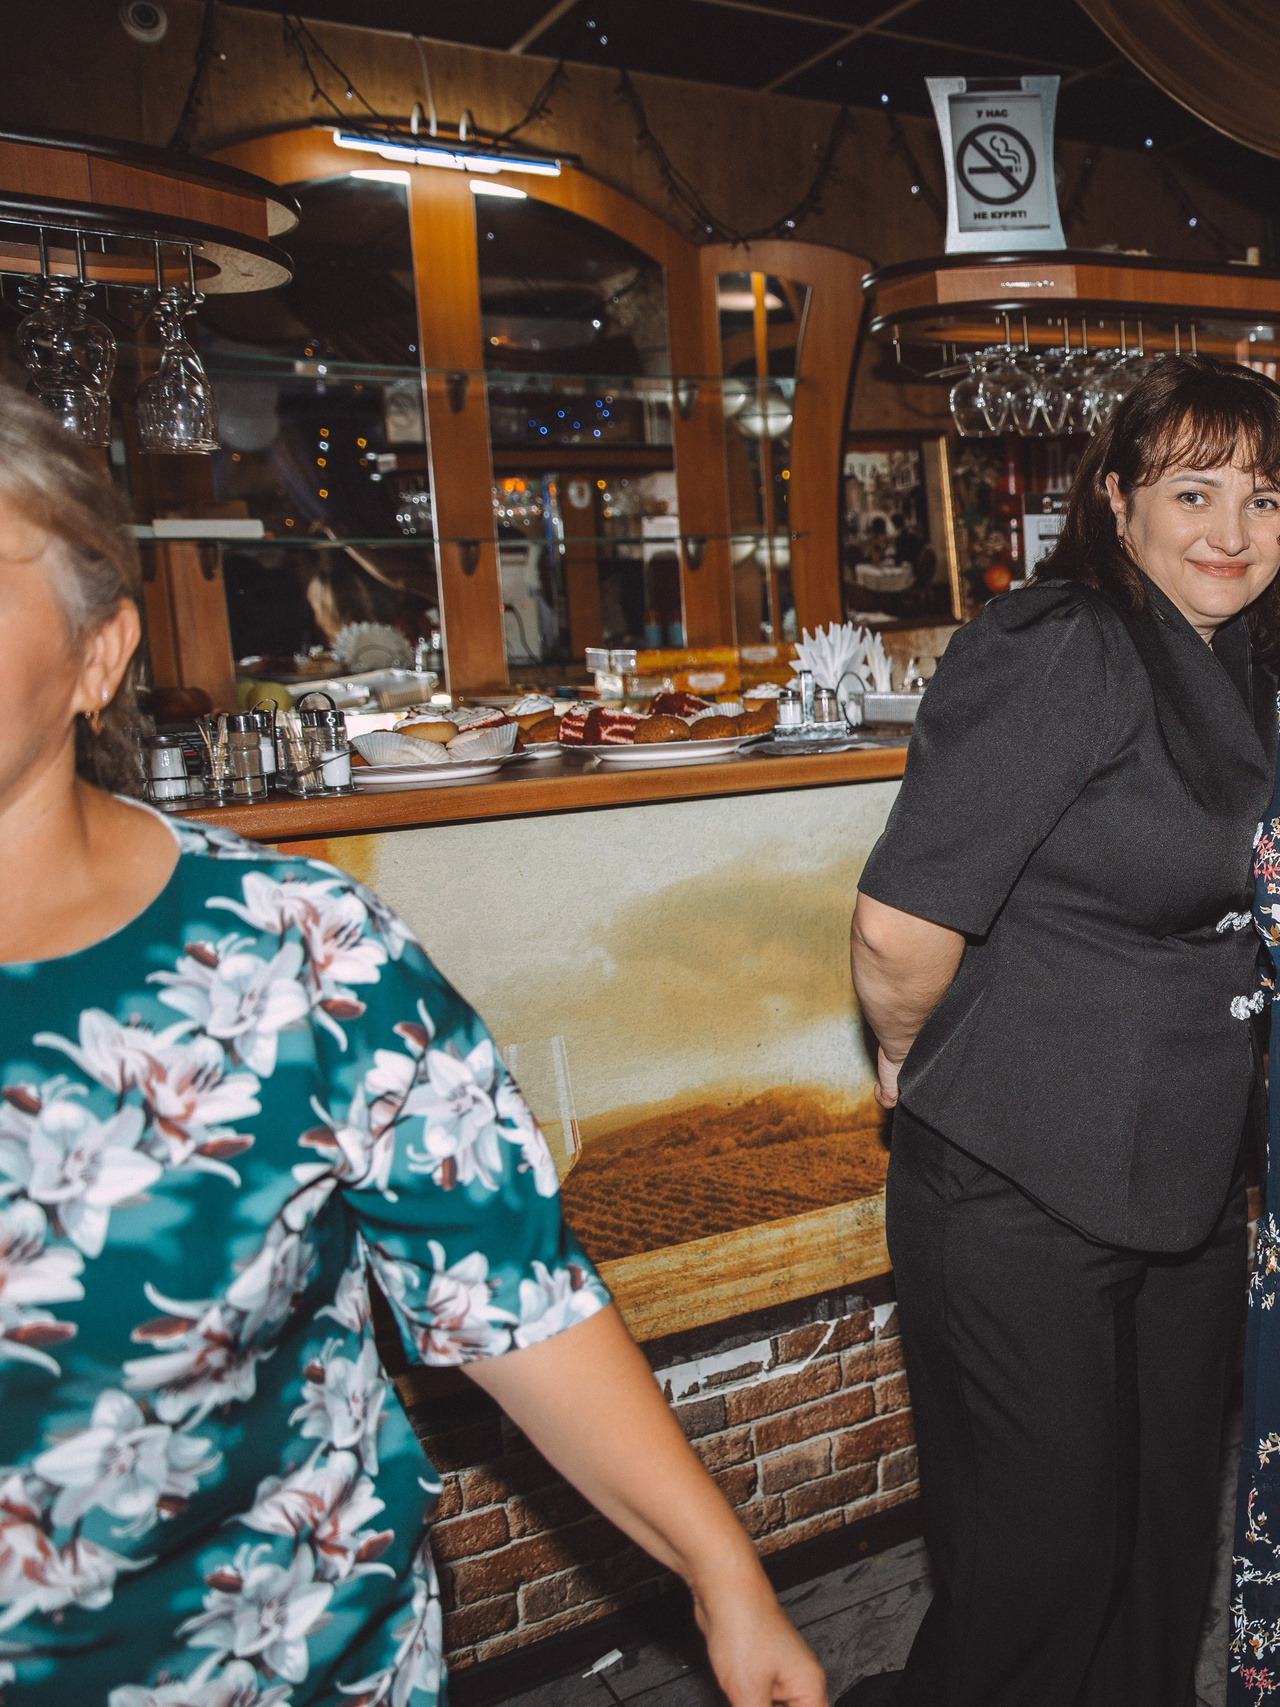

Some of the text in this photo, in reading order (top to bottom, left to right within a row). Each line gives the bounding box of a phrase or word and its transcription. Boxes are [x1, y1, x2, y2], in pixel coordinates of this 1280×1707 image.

[976, 108, 1009, 119] У НАС
[973, 210, 1028, 220] НЕ КУРЯТ!
